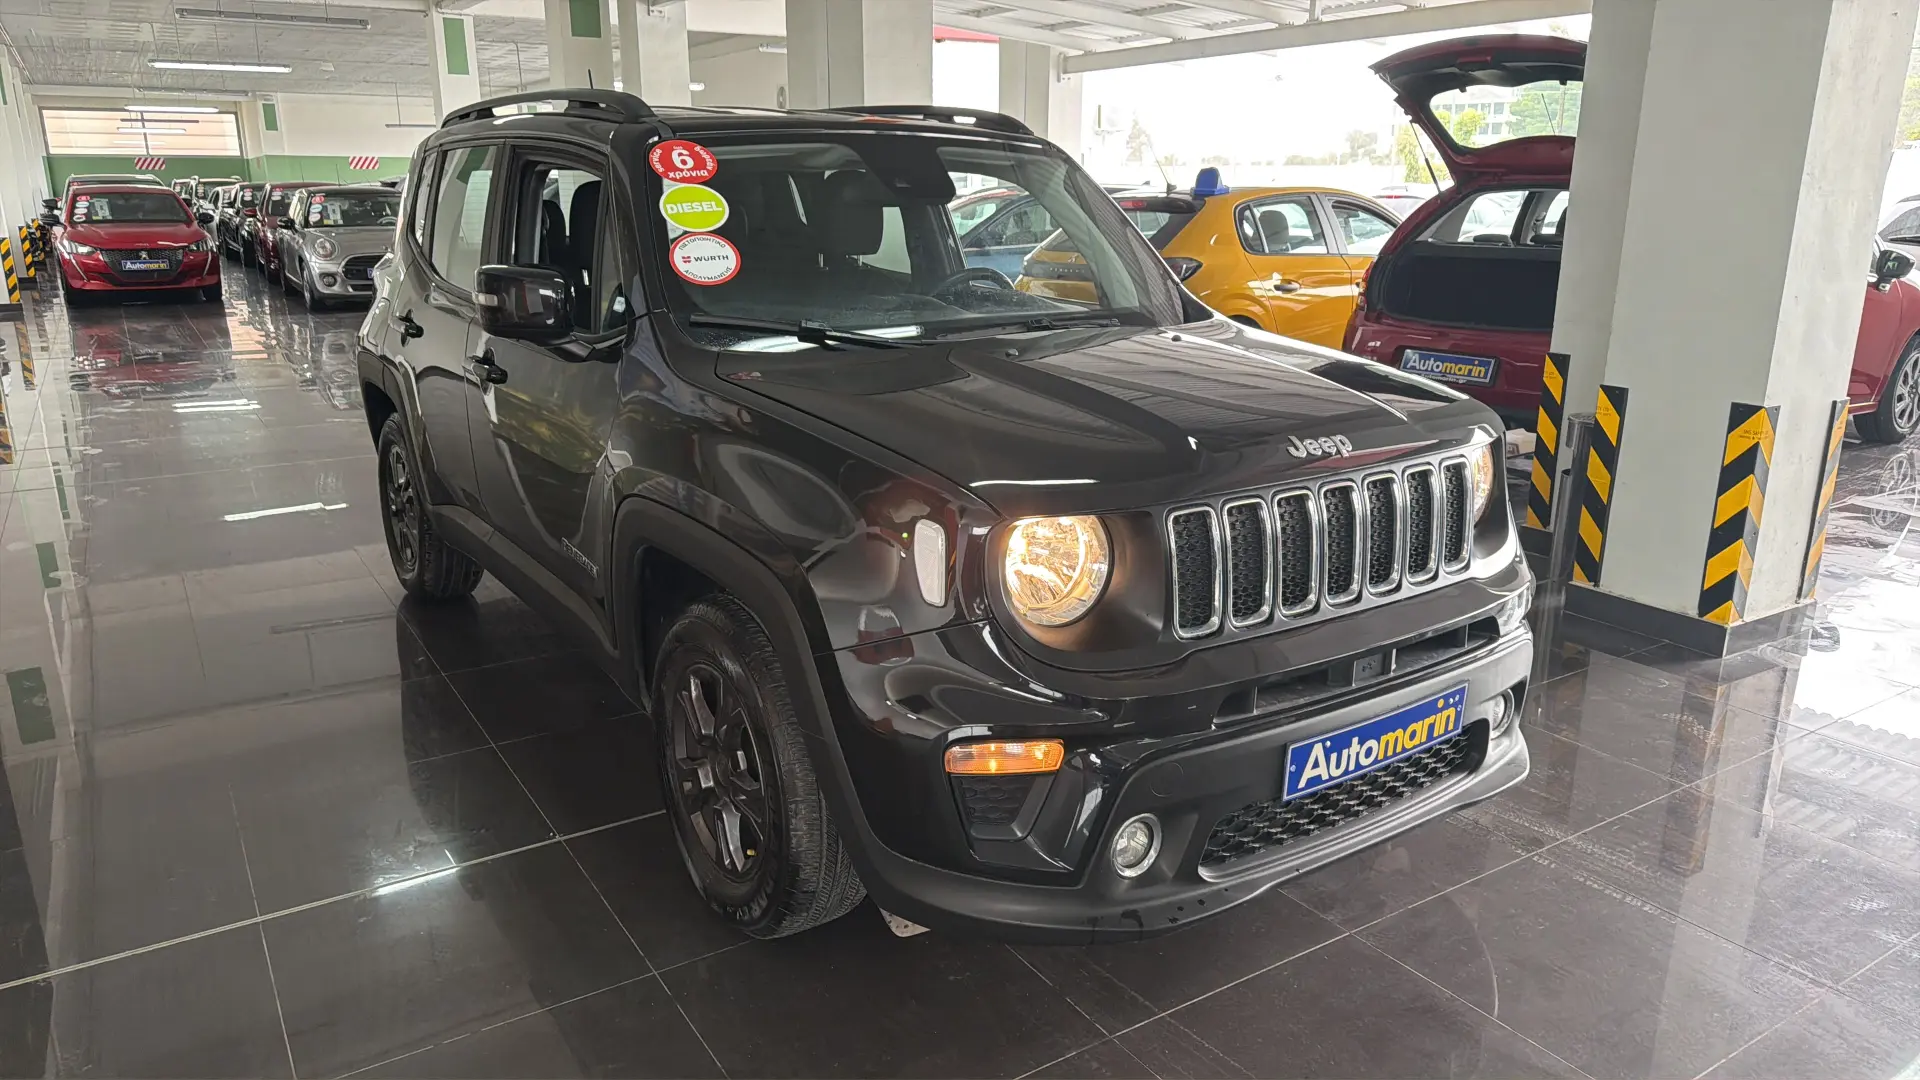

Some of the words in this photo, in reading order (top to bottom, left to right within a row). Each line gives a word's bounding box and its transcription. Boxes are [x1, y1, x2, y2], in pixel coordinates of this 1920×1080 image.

[650, 148, 665, 173] service
[671, 148, 695, 170] 6
[667, 169, 709, 179] χρόνια
[665, 201, 723, 215] DIESEL
[1406, 353, 1486, 378] Automarin
[1286, 434, 1353, 459] Jeep
[1297, 698, 1456, 789] Automarin
